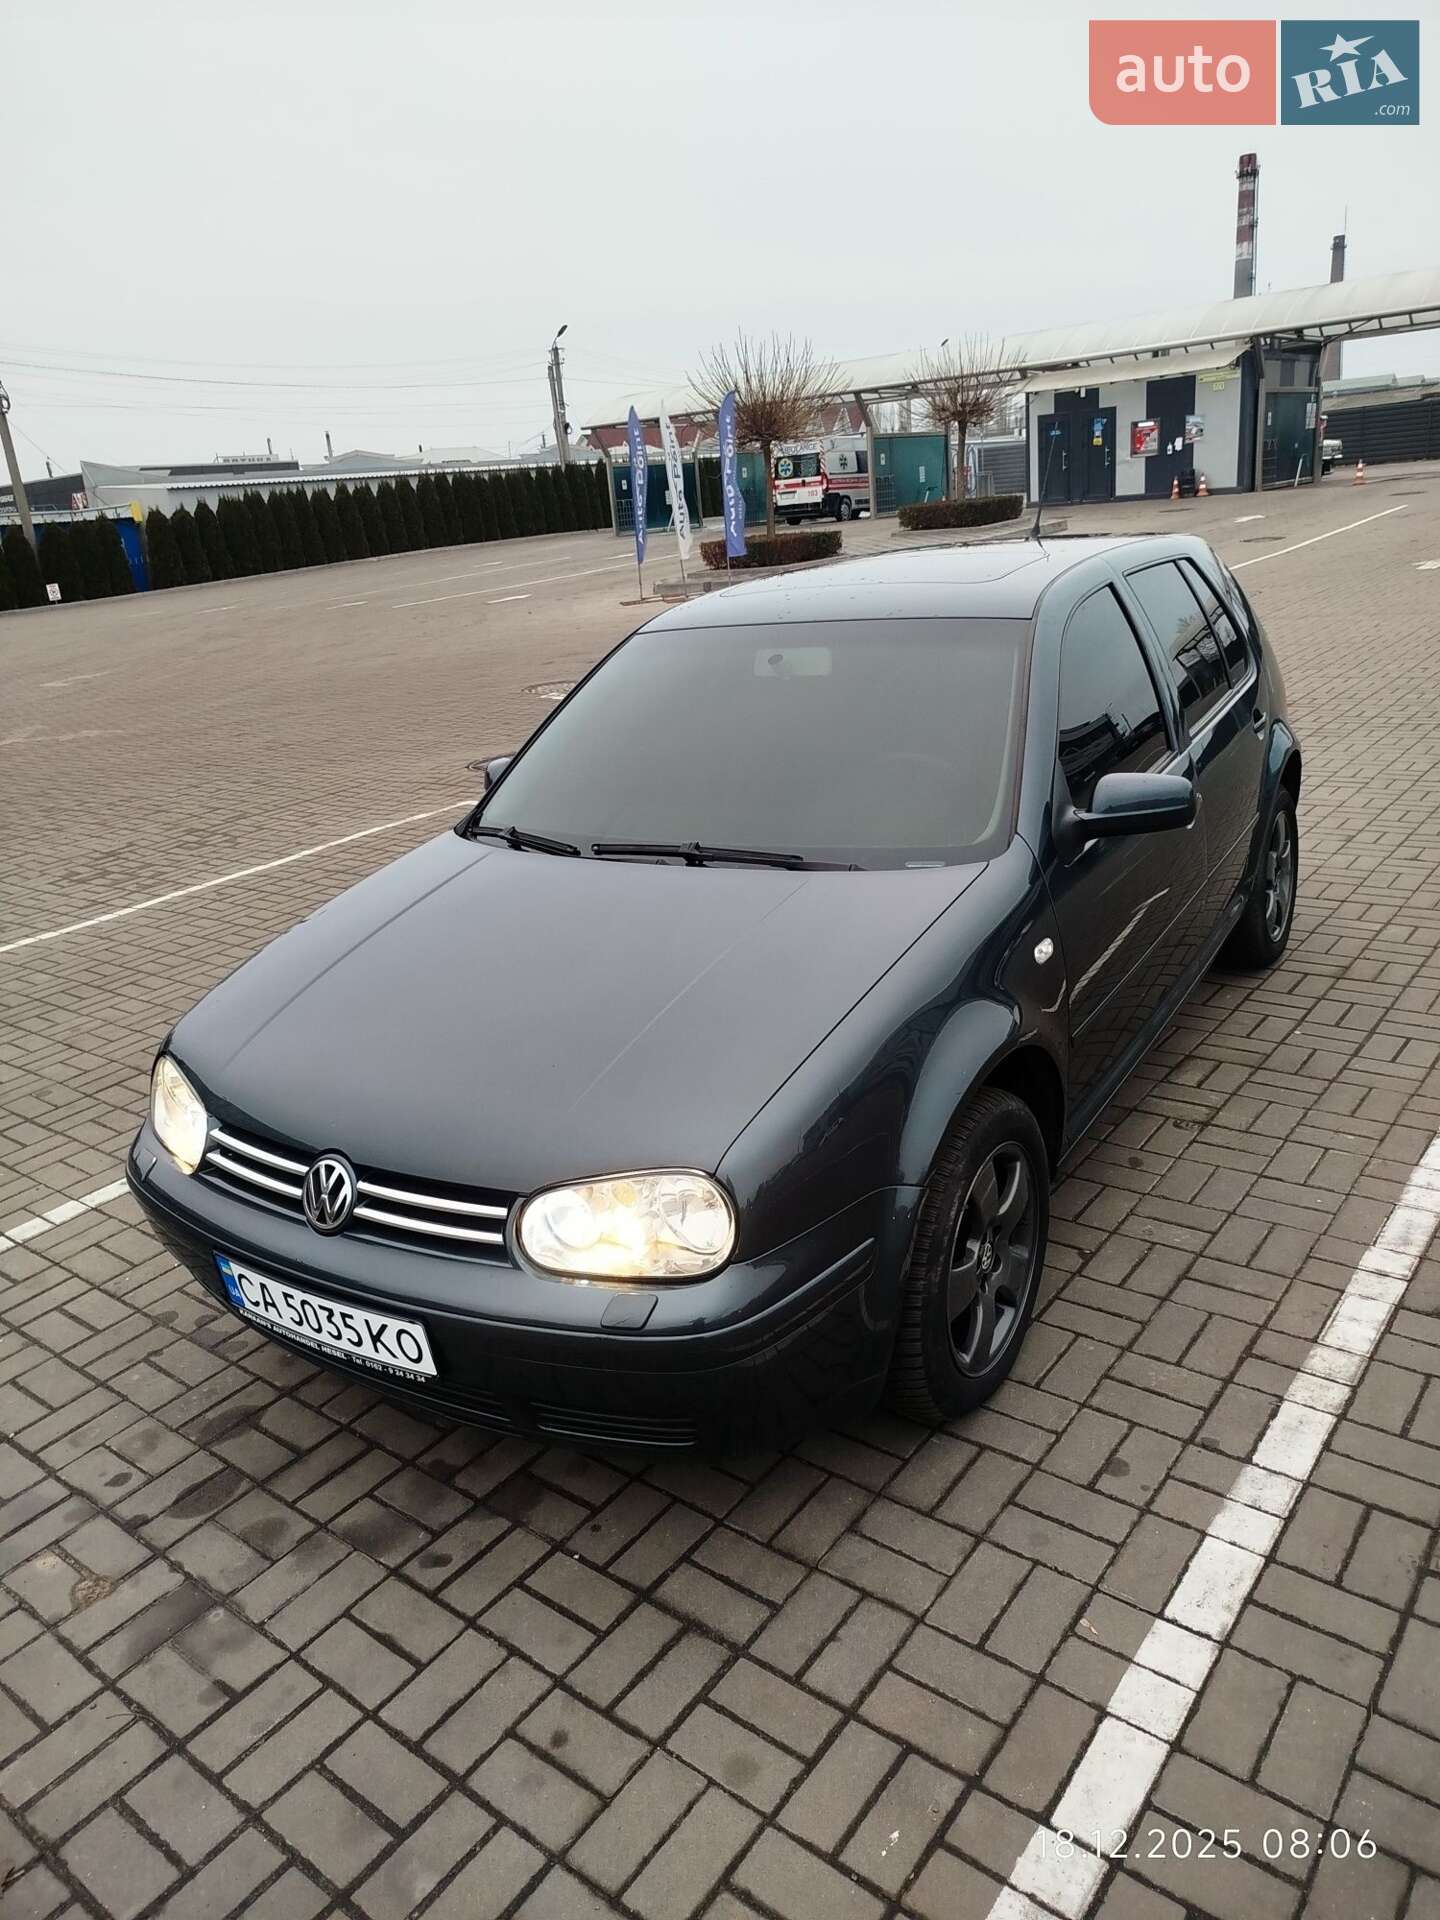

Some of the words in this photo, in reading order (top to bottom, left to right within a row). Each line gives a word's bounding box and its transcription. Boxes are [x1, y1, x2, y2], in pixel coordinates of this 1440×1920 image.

[807, 489, 819, 497] 103
[677, 489, 687, 540] Auto
[228, 1285, 240, 1297] UA
[273, 1325, 320, 1350] AUTOHANDEL
